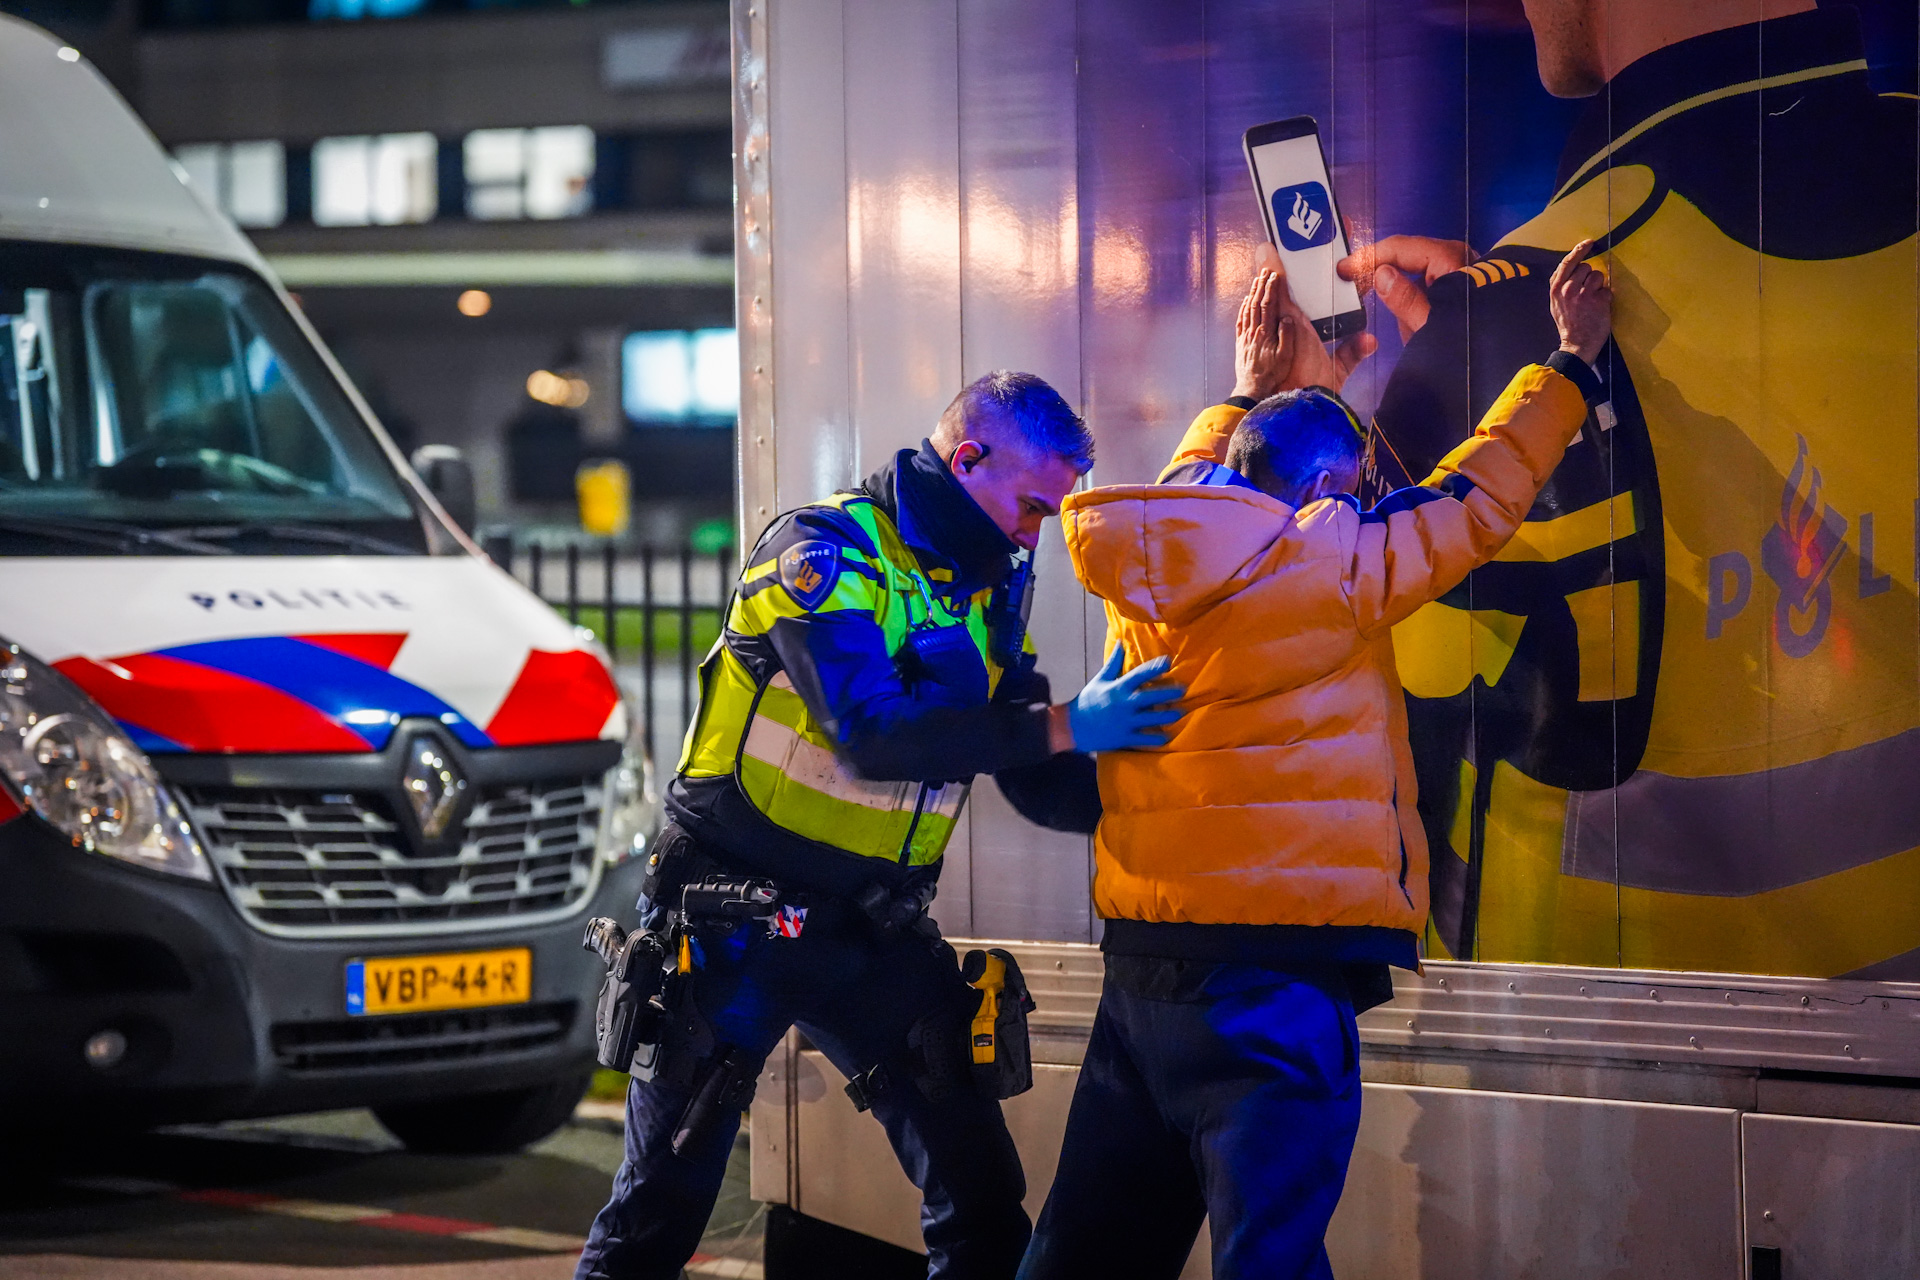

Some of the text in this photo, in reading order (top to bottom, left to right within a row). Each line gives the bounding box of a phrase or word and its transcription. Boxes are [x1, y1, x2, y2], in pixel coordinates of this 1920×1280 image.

[785, 549, 830, 566] POLITIE
[188, 589, 411, 612] POLITIE
[374, 960, 517, 1002] VBP-44-R
